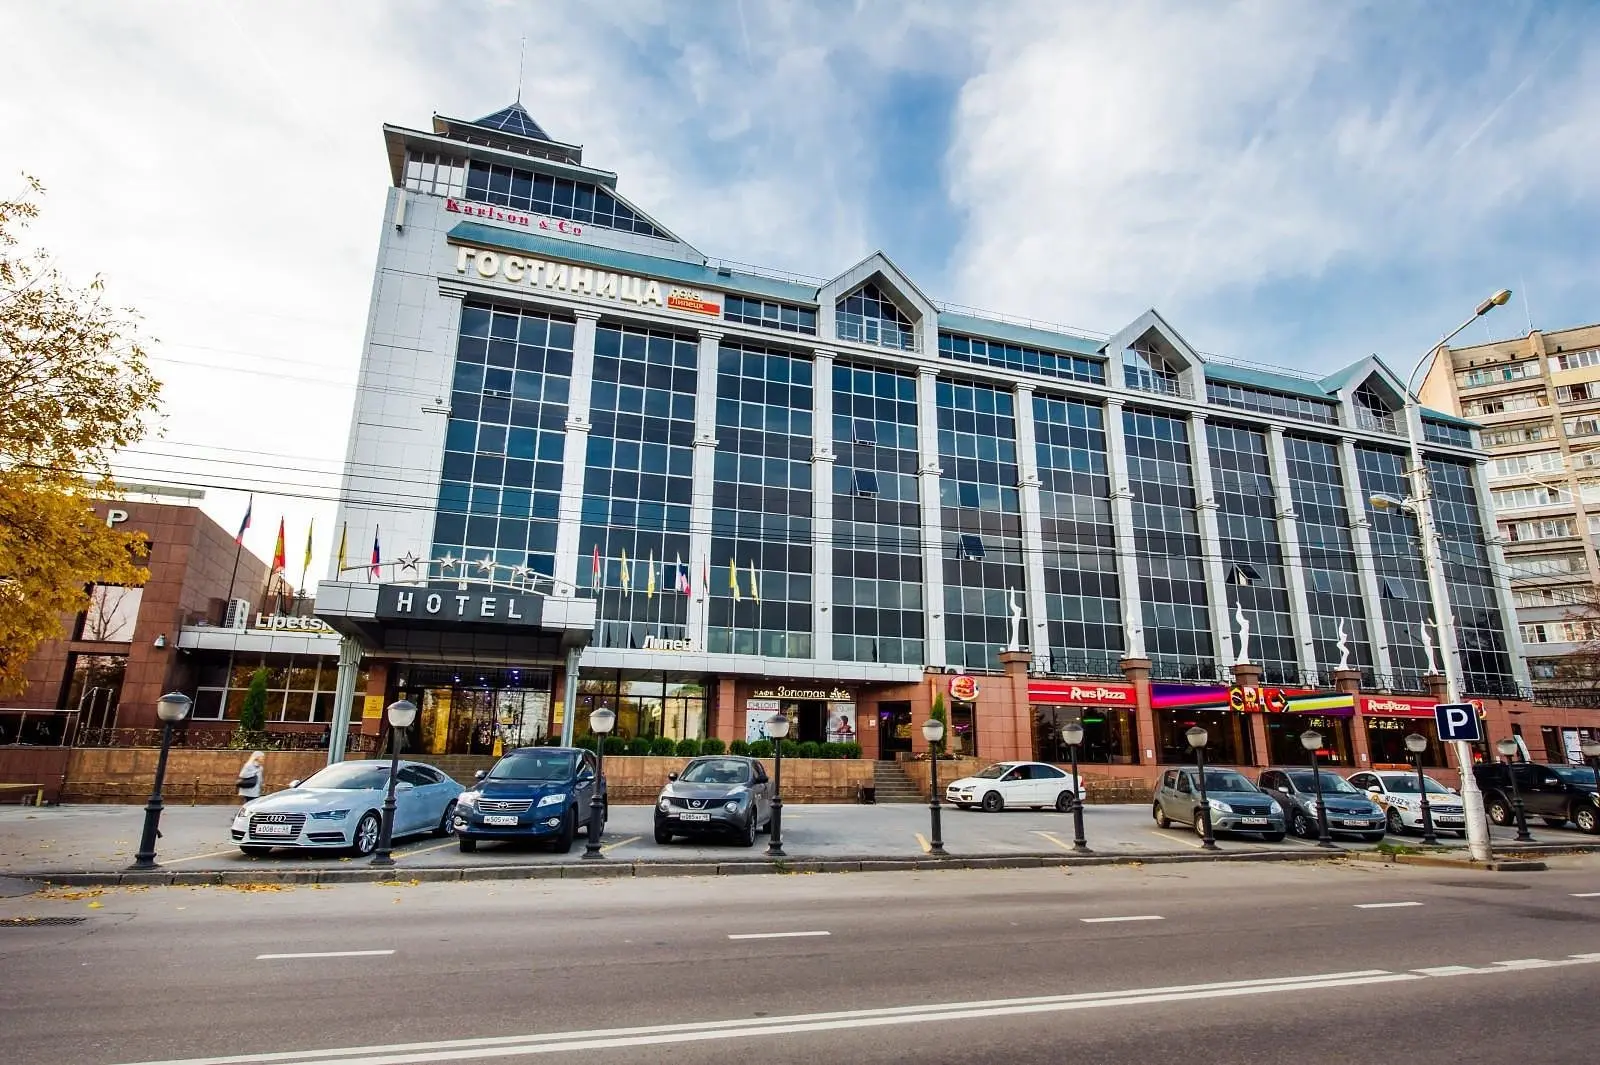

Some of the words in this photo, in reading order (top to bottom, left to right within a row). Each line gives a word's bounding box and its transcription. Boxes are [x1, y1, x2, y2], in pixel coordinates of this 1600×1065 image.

[446, 198, 529, 226] Karlson
[539, 220, 549, 230] &
[558, 221, 582, 236] Co
[456, 246, 664, 307] ГОСТИНИЦА
[396, 591, 522, 619] HOTEL
[1446, 708, 1469, 737] P
